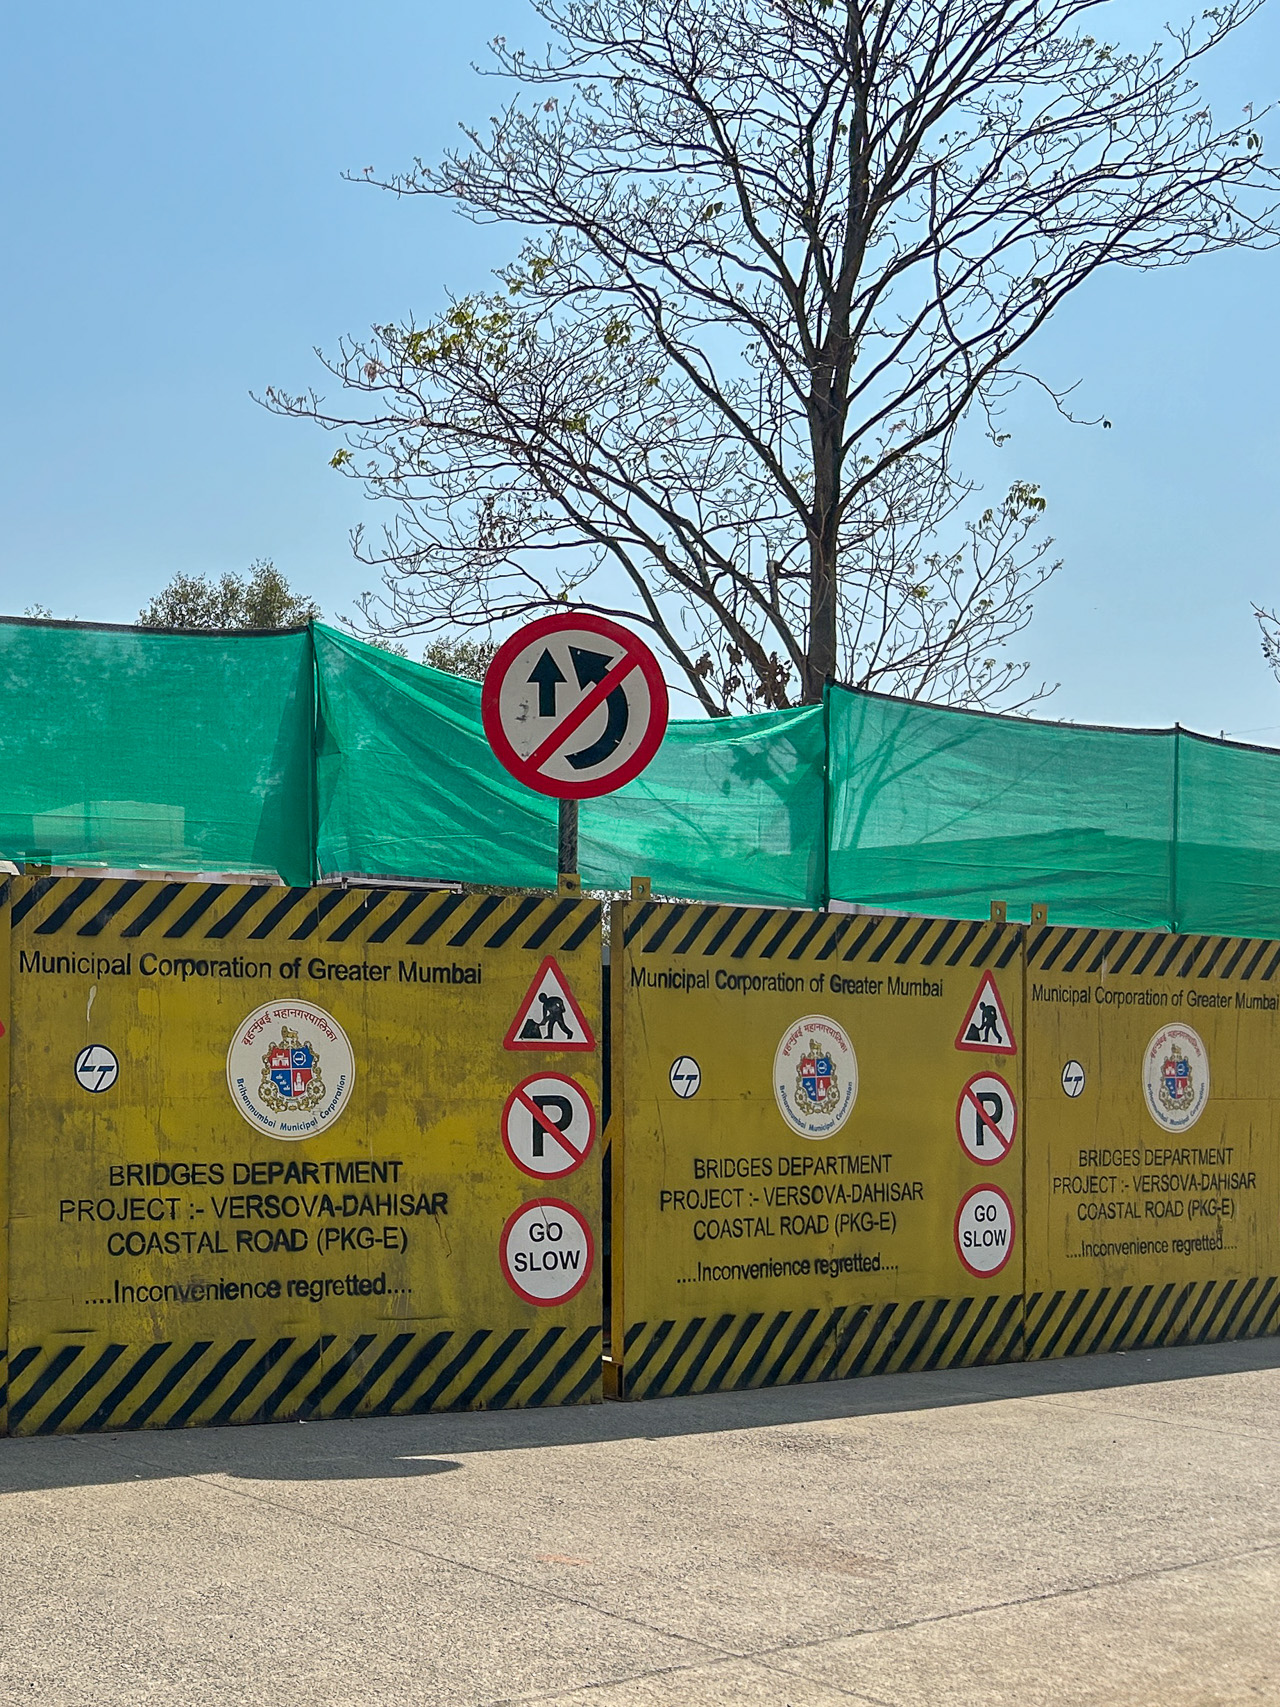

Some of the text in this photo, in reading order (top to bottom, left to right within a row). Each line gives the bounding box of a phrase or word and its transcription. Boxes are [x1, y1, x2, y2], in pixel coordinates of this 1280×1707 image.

[20, 950, 482, 984] Municipal Corporation of Greater Mumbai
[630, 966, 943, 998] Municipal Corporation of Greater Mumbai
[1032, 984, 1280, 1010] Municipal Corporation of Greater Mumbai
[236, 1074, 346, 1131] Brihanmumbai Municipal Corporation
[532, 1095, 573, 1157] P
[975, 1092, 1003, 1146] P
[693, 1154, 893, 1179] BRIDGES DEPARTMENT
[1079, 1147, 1234, 1167] BRIDGES DEPARTMENT
[109, 1161, 403, 1186] BRIDGES DEPARTMENT
[1053, 1176, 1117, 1194] PROJECT
[1133, 1172, 1257, 1192] VERSOVA-DAHISAR
[59, 1198, 181, 1222] PROJECT
[211, 1192, 448, 1220] VERSOVA-DAHISAR
[660, 1188, 744, 1212] PROJECT
[763, 1181, 924, 1207] VERSOVA-DAHISAR
[1077, 1198, 1235, 1221] COASTAL ROAD (PKG-E)
[693, 1210, 897, 1241] COASTAL ROAD (PKG-E)
[974, 1204, 997, 1222] GO
[107, 1226, 408, 1256] COASTAL ROAD (PKG-E)
[528, 1222, 563, 1243] GO
[963, 1229, 1007, 1248] SLOW
[514, 1250, 580, 1272] SLOW
